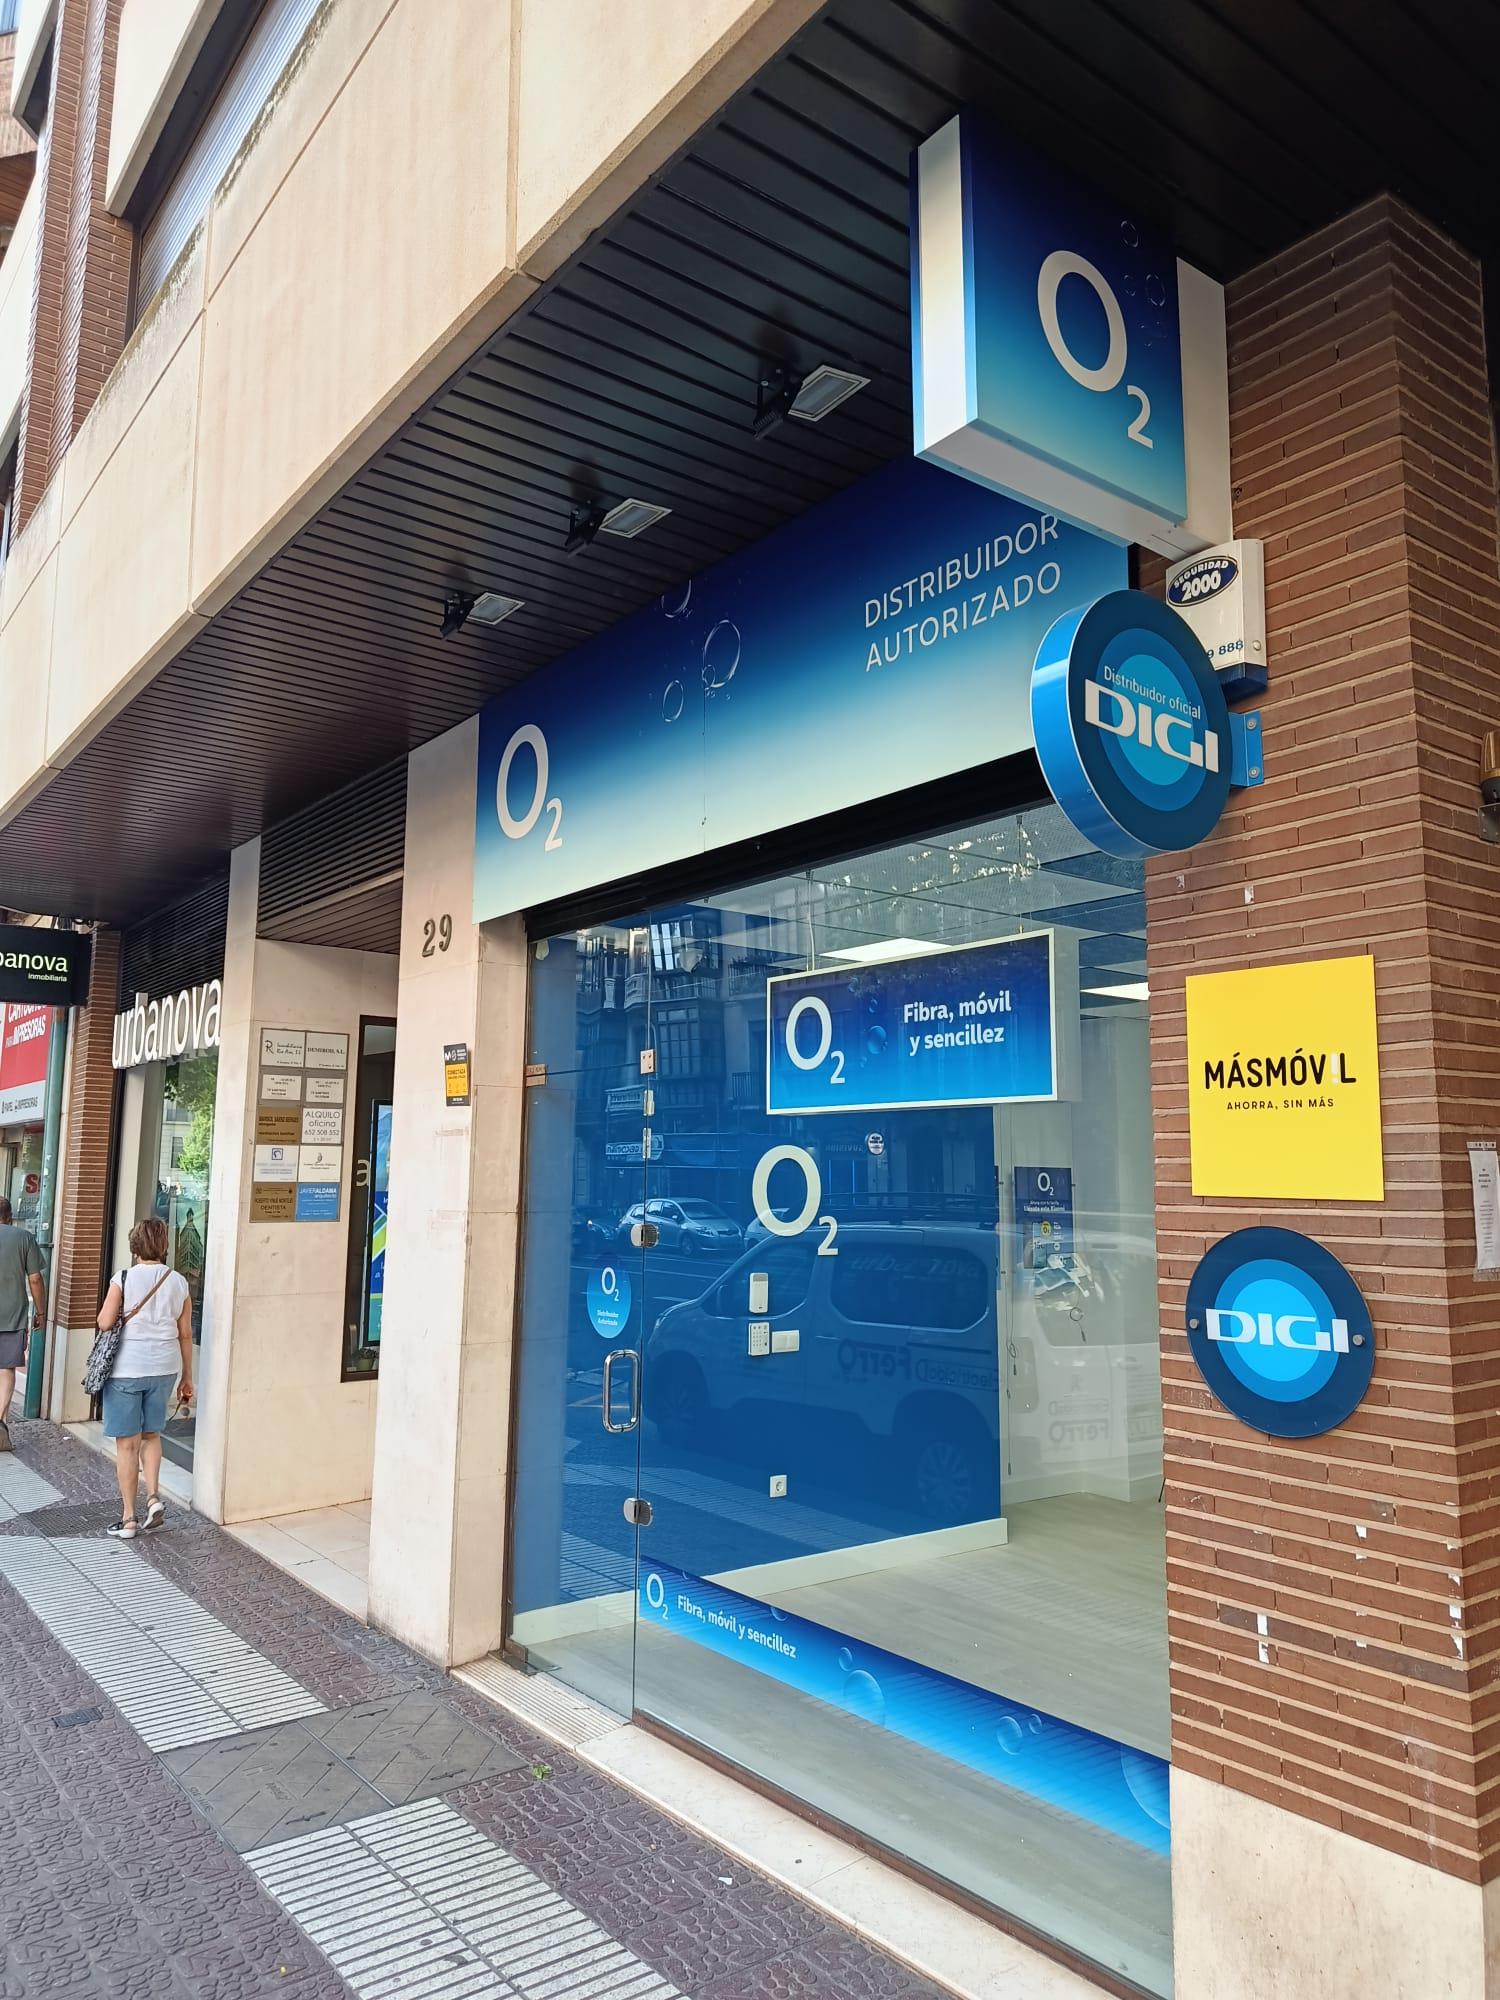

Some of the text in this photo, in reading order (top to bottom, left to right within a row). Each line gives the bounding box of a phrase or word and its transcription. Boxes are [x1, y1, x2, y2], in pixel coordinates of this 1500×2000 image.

[865, 512, 1059, 628] DISTRIBUIDOR
[1174, 560, 1229, 588] SEGURIDAD
[1181, 570, 1222, 602] 2000
[865, 562, 1061, 672] AUTORIZADO
[1218, 640, 1244, 655] 888
[1104, 665, 1201, 720] Distribuidor oficial
[1085, 679, 1219, 774] DIGI
[421, 913, 453, 958] 29
[112, 979, 222, 1069] urbanova
[903, 990, 1012, 1024] Fibra, móvil
[909, 1024, 1005, 1056] y sencillez
[305, 1111, 341, 1119] ALQUILO
[1226, 1096, 1335, 1110] AHORRA, SIN MÁS
[1205, 1308, 1350, 1353] DIGI
[677, 1594, 706, 1623] Fibra,
[708, 1610, 737, 1634] móvil
[738, 1624, 745, 1640] y
[747, 1627, 798, 1659] sencillez
